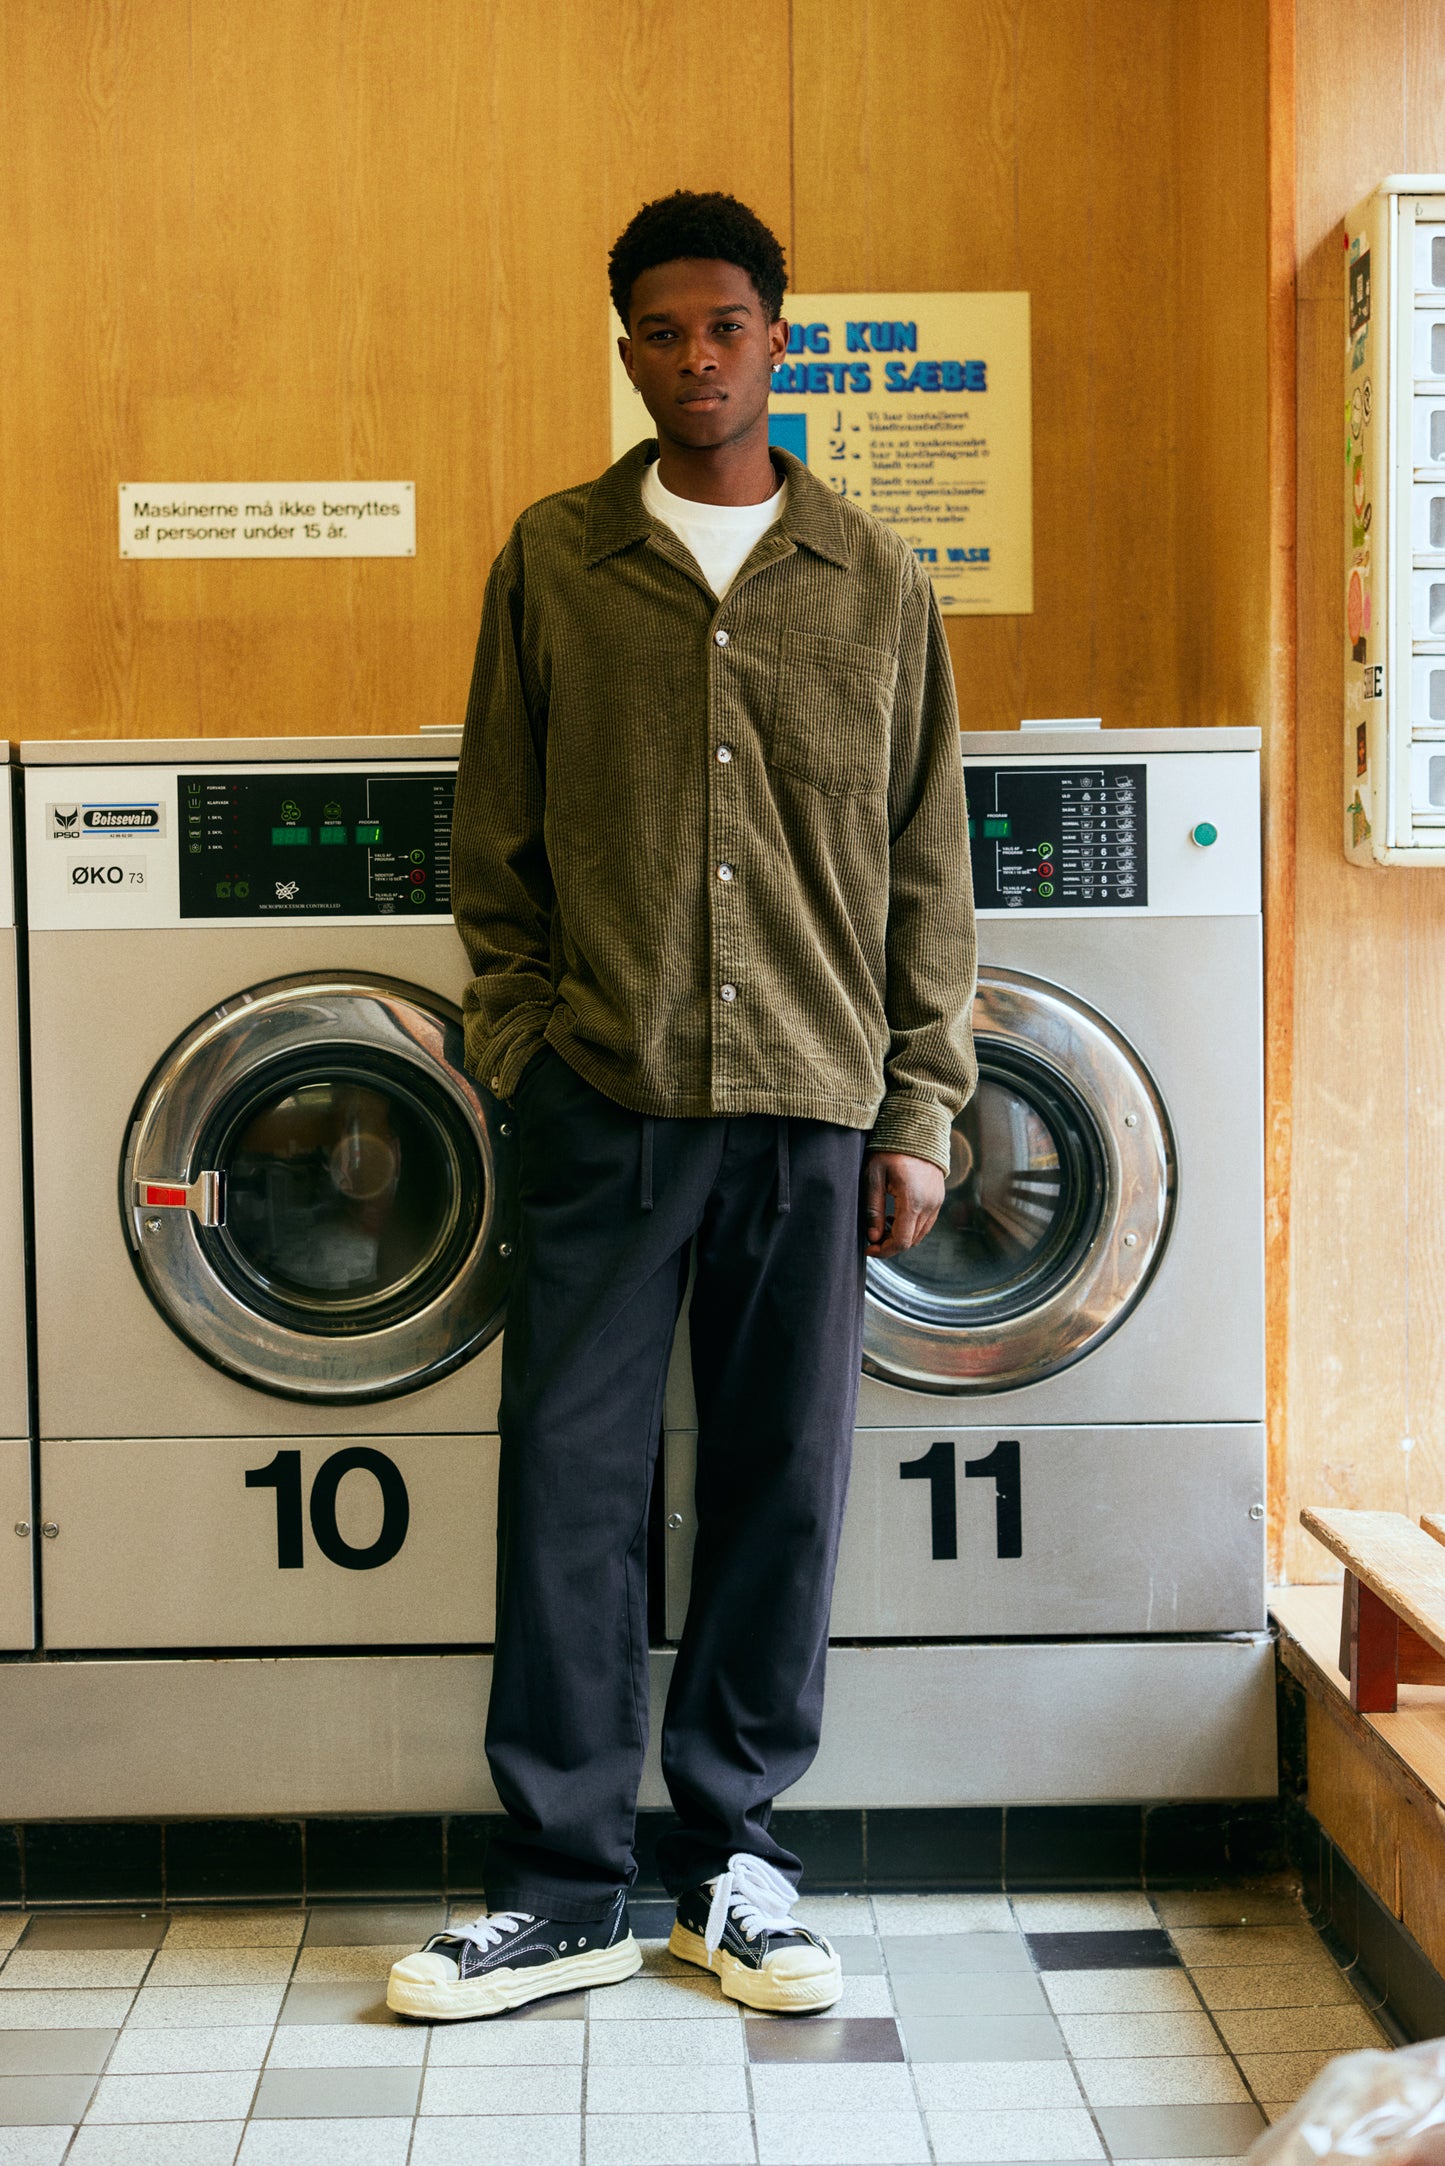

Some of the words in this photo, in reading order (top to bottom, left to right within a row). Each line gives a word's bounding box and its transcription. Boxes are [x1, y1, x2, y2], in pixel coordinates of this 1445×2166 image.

[786, 322, 830, 354] UG
[846, 321, 917, 353] KUN
[770, 361, 871, 394] RIETS
[884, 360, 987, 393] SÆBE
[134, 502, 239, 518] Maskinerne
[245, 501, 274, 517] må
[280, 501, 316, 517] ikke
[322, 500, 401, 520] benyttes
[134, 525, 150, 540] af
[157, 525, 237, 543] personer
[244, 525, 295, 539] under
[303, 524, 321, 539] 15
[327, 523, 348, 539] år.
[1100, 778, 1105, 786] 1
[1100, 793, 1106, 801] 2
[1100, 806, 1106, 815] 3
[91, 811, 152, 826] Boissevain
[1100, 820, 1107, 828] 4
[53, 831, 80, 839] IPSO
[1100, 834, 1107, 842] 5
[1100, 848, 1107, 856] 6
[1101, 862, 1107, 870] 7
[72, 866, 124, 885] ØKO
[128, 872, 144, 884] 73
[1101, 875, 1107, 883] 8
[1101, 889, 1108, 897] 9
[899, 1440, 1023, 1560] 11
[245, 1446, 410, 1570] 10
